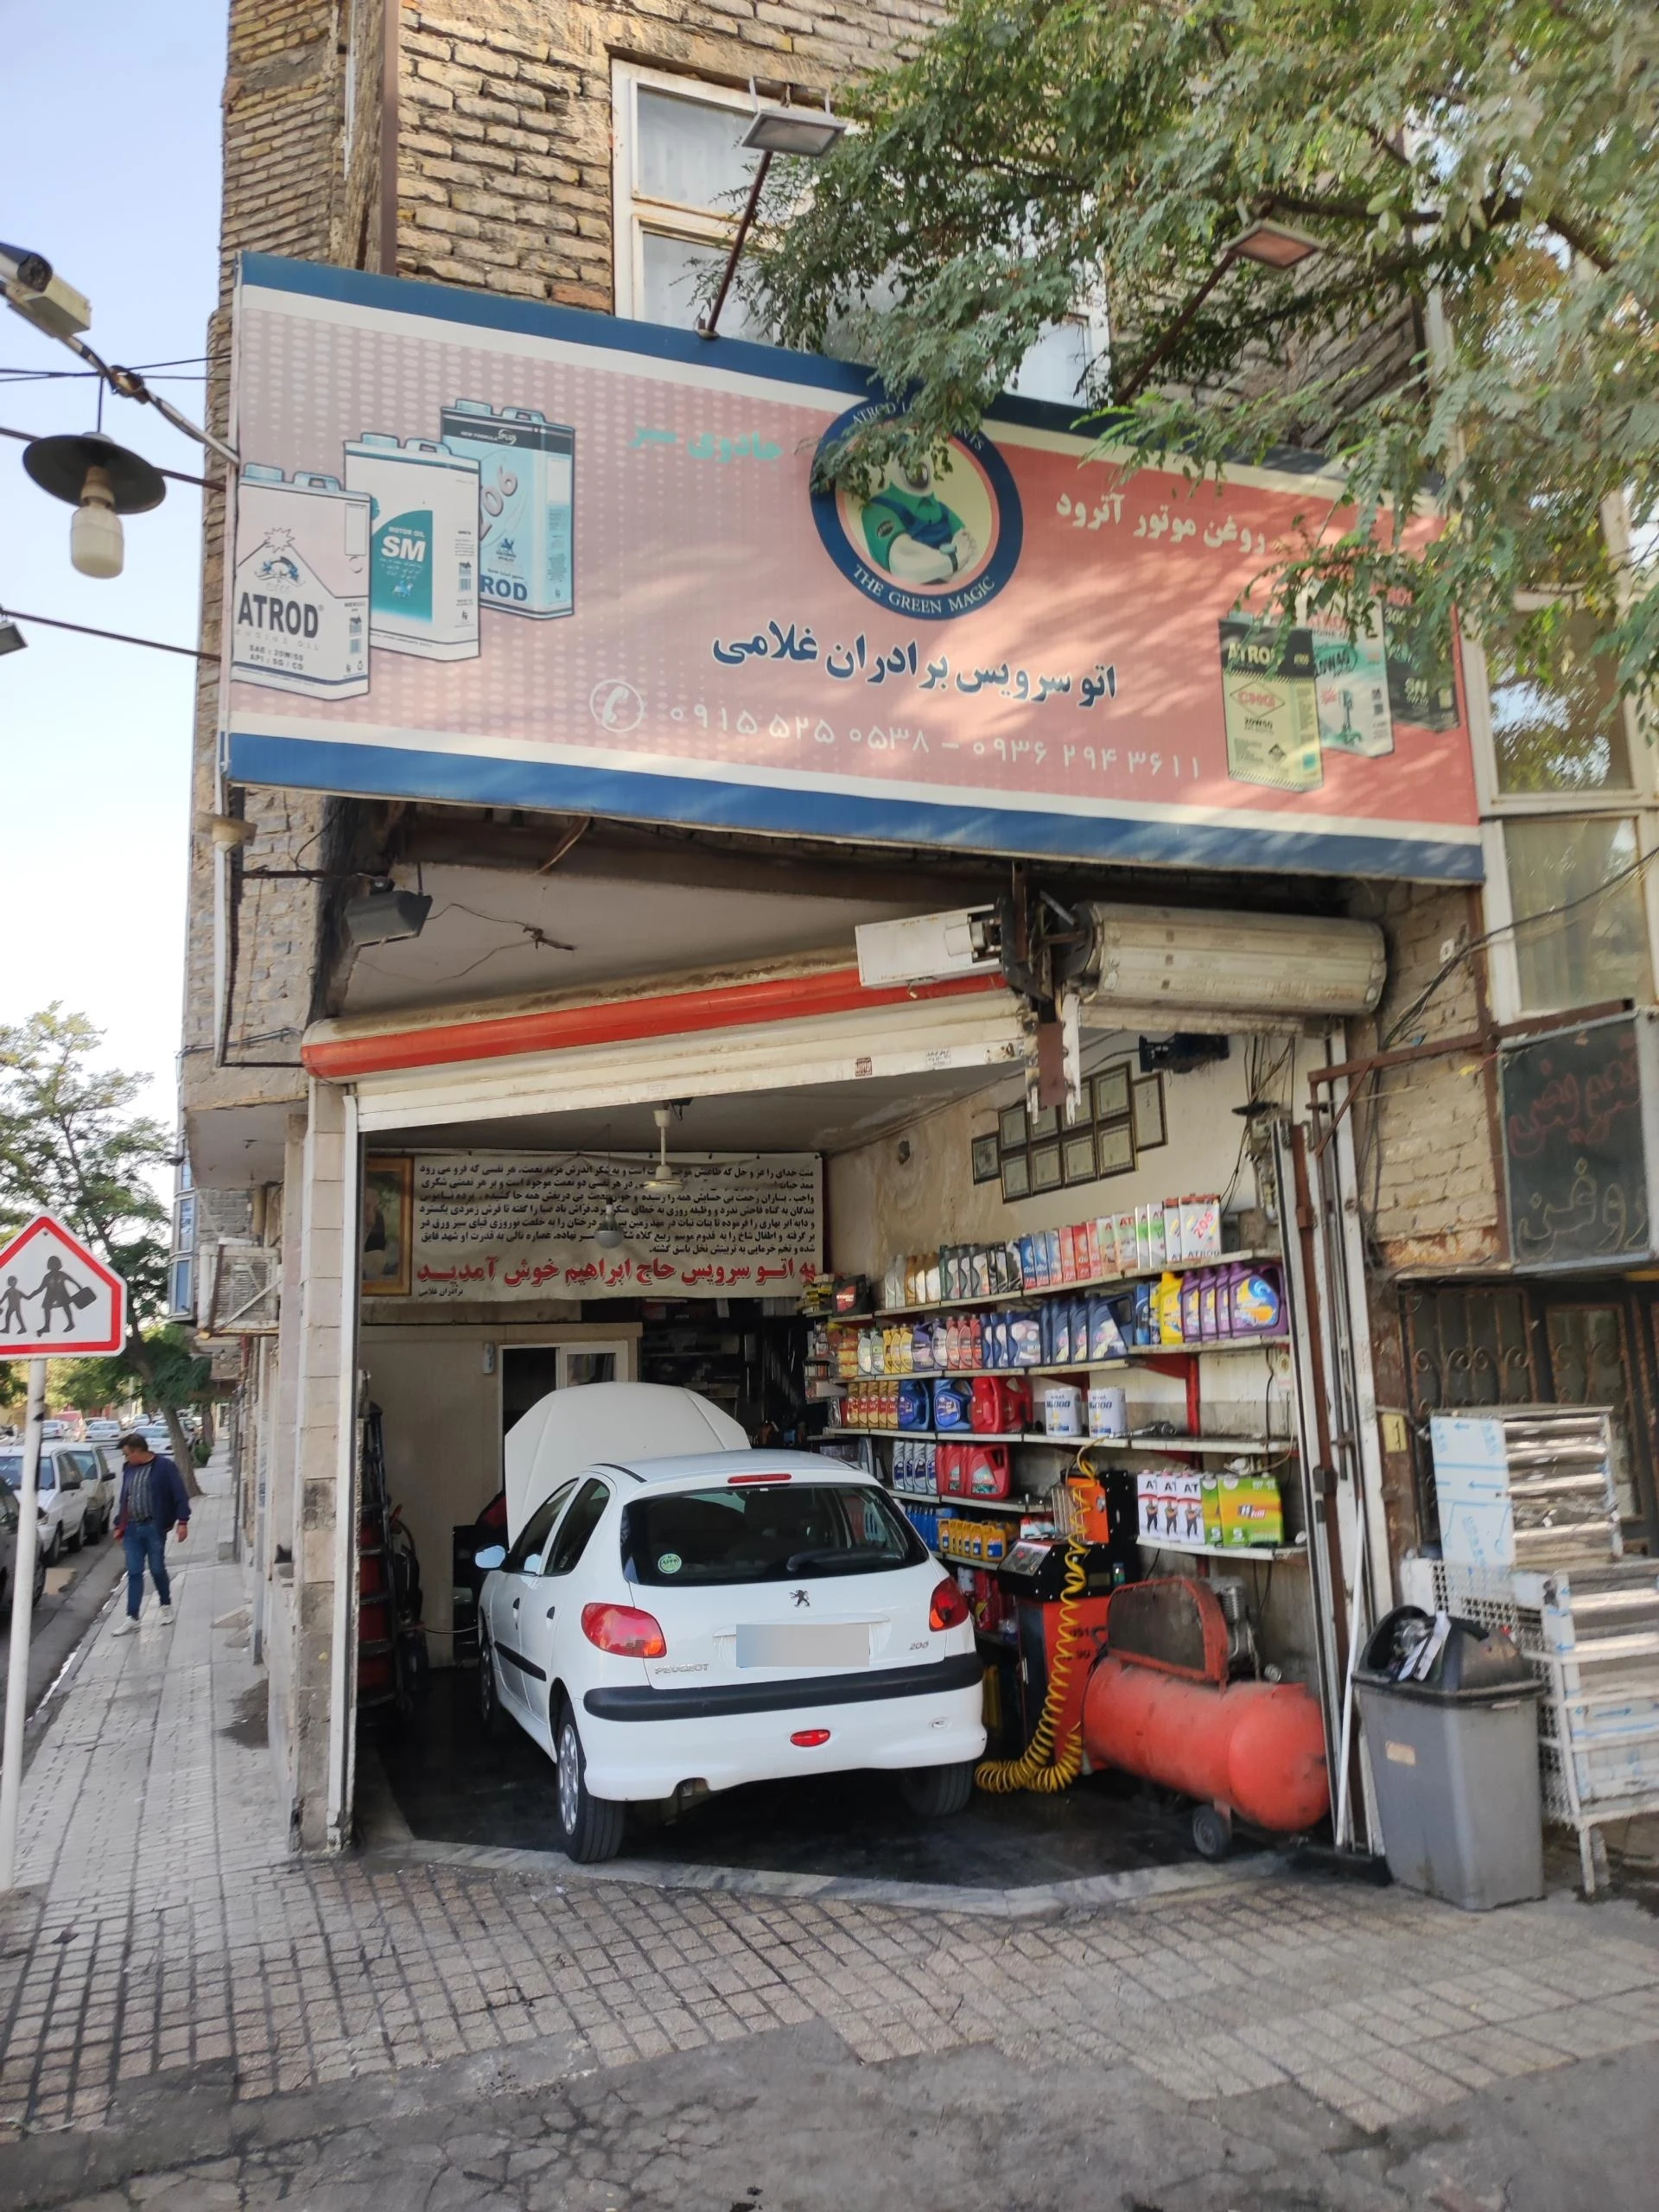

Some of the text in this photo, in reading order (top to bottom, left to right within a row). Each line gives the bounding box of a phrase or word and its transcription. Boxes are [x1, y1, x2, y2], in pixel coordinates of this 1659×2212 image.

[1056, 493, 1265, 554] روغن موتور آترود
[381, 535, 426, 563] SM
[480, 575, 527, 601] ROD
[853, 564, 995, 614] THE GREEN MAGIC
[238, 592, 318, 639] ATROD
[712, 620, 1118, 707] اتو سرویس برادران غلامی
[671, 703, 759, 734] ۰۹۱۵
[769, 714, 836, 744] ۵۲۵
[849, 725, 930, 753] ۰۵۳۸
[416, 1255, 500, 1287] آمدید
[504, 1257, 560, 1287] خوش
[565, 1257, 632, 1287] ابراهیم
[636, 1257, 676, 1285] حاج
[681, 1263, 751, 1286] سرویس
[755, 1257, 795, 1285] اتو
[654, 1663, 710, 1675] PEUGEOT
